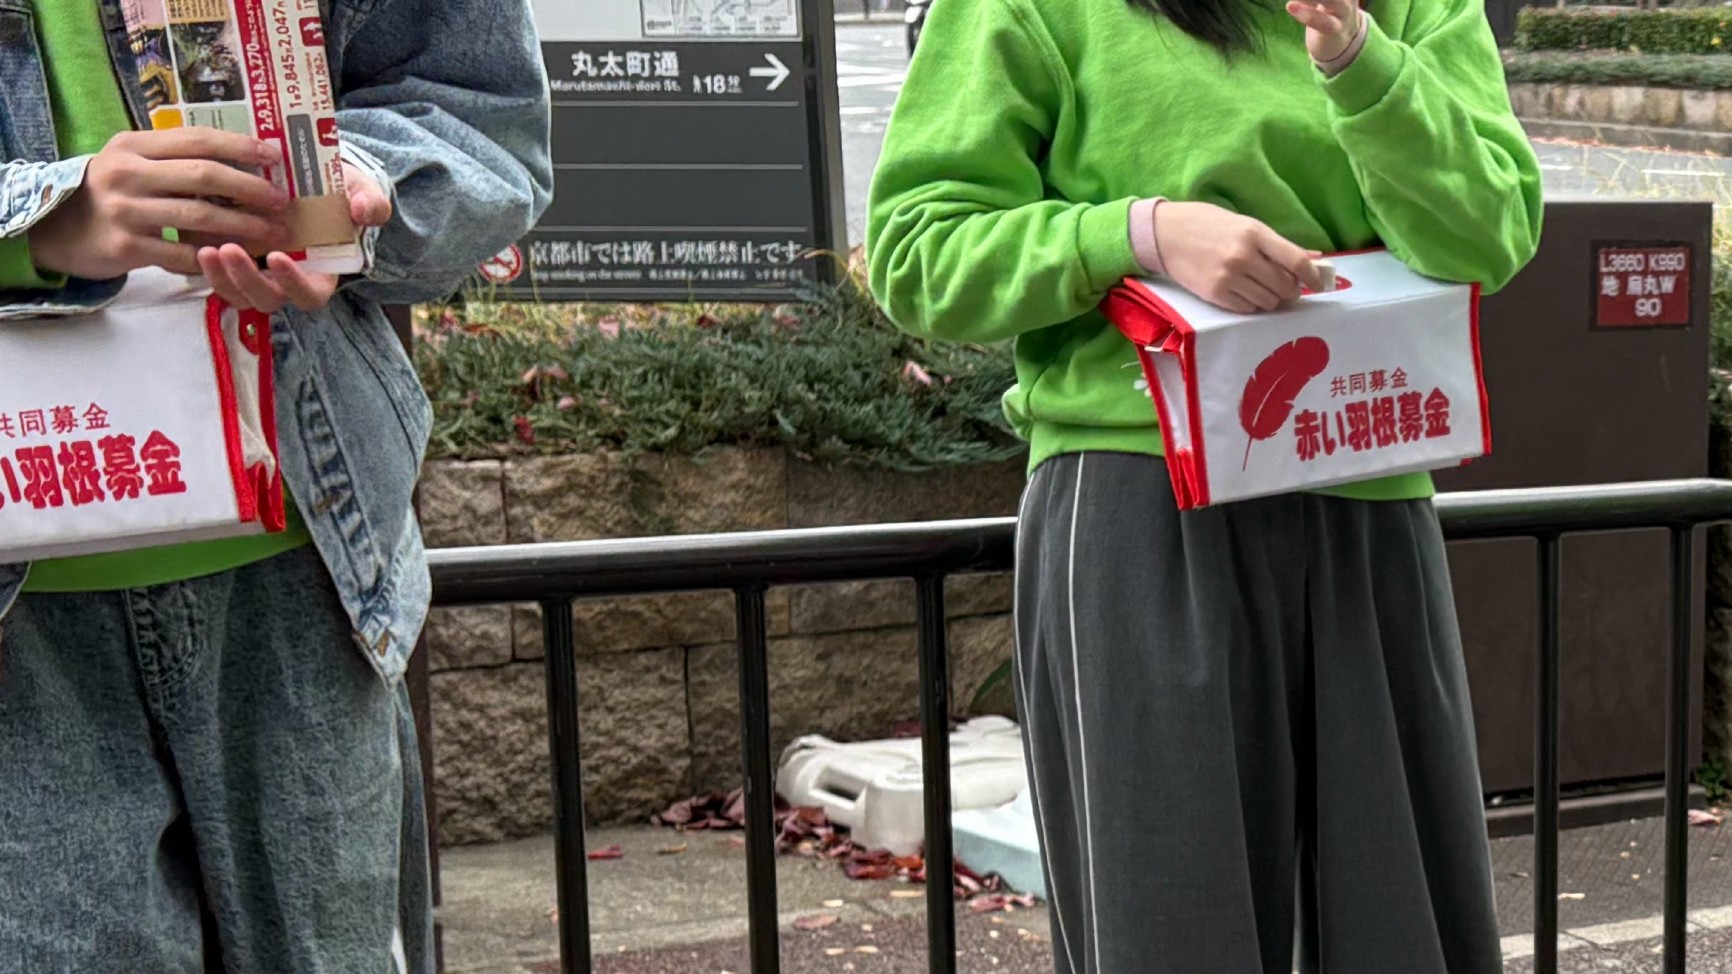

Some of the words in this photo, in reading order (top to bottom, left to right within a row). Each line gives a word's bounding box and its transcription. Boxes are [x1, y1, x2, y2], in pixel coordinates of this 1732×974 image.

[571, 50, 680, 78] 丸太町通
[1330, 366, 1409, 398] 共同募金
[1293, 387, 1451, 462] 赤い羽根募金
